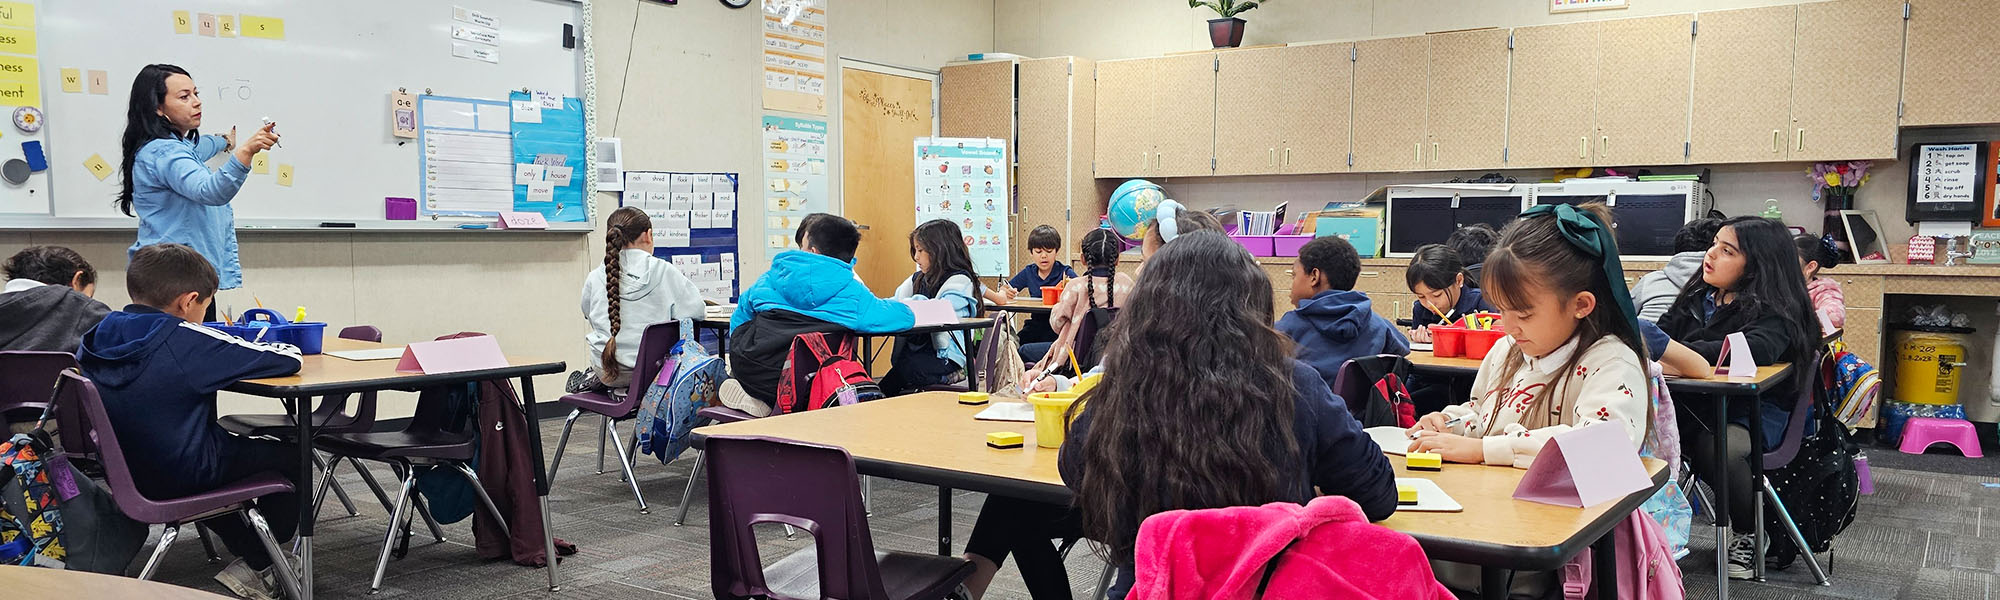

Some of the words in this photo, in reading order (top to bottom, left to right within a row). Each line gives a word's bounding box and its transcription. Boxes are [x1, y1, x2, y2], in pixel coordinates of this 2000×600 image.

[178, 16, 185, 25] b
[223, 23, 230, 31] g
[523, 169, 536, 180] only
[550, 171, 567, 179] house
[928, 205, 931, 213] i
[704, 267, 718, 278] pretty
